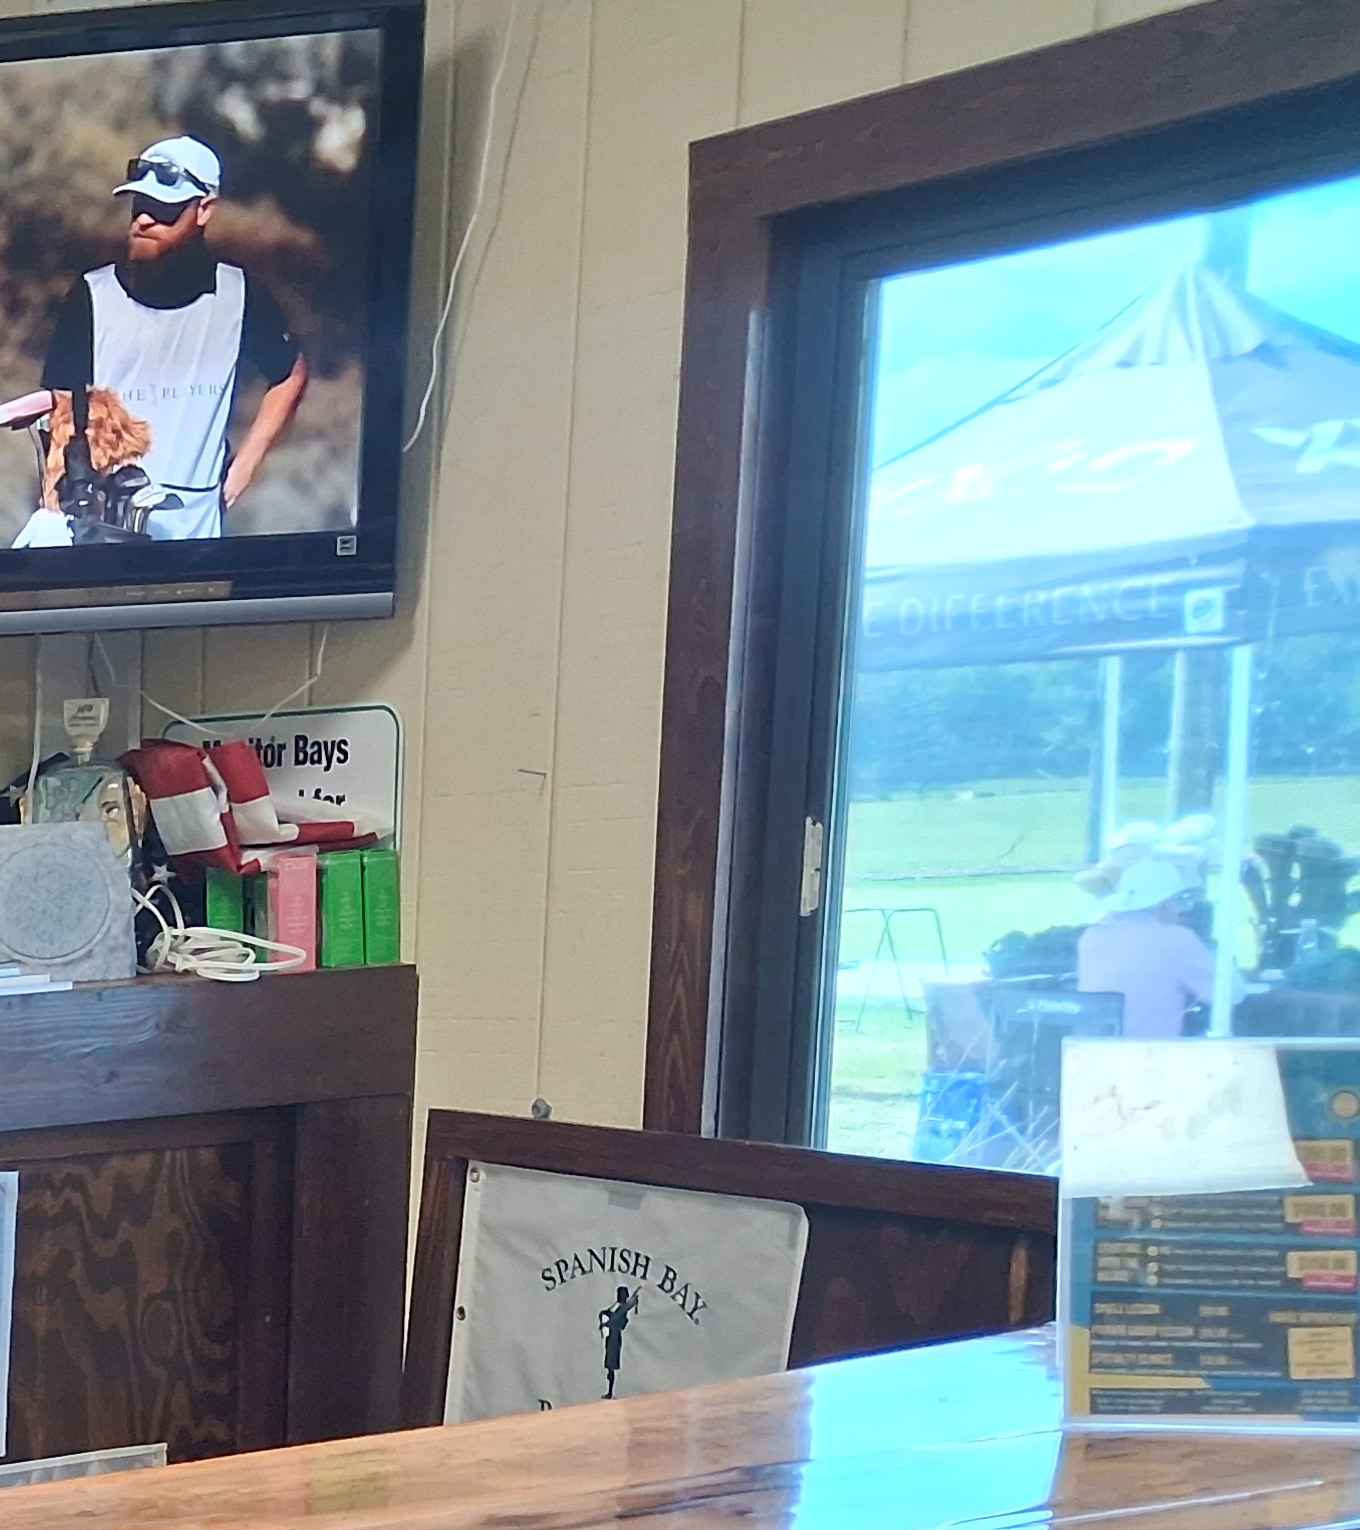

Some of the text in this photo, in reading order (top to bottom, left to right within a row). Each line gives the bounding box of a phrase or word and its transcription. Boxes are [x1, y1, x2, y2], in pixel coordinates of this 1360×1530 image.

[162, 383, 227, 399] PLYERS
[294, 734, 349, 772] Bays
[541, 1246, 654, 1292] SPANISH
